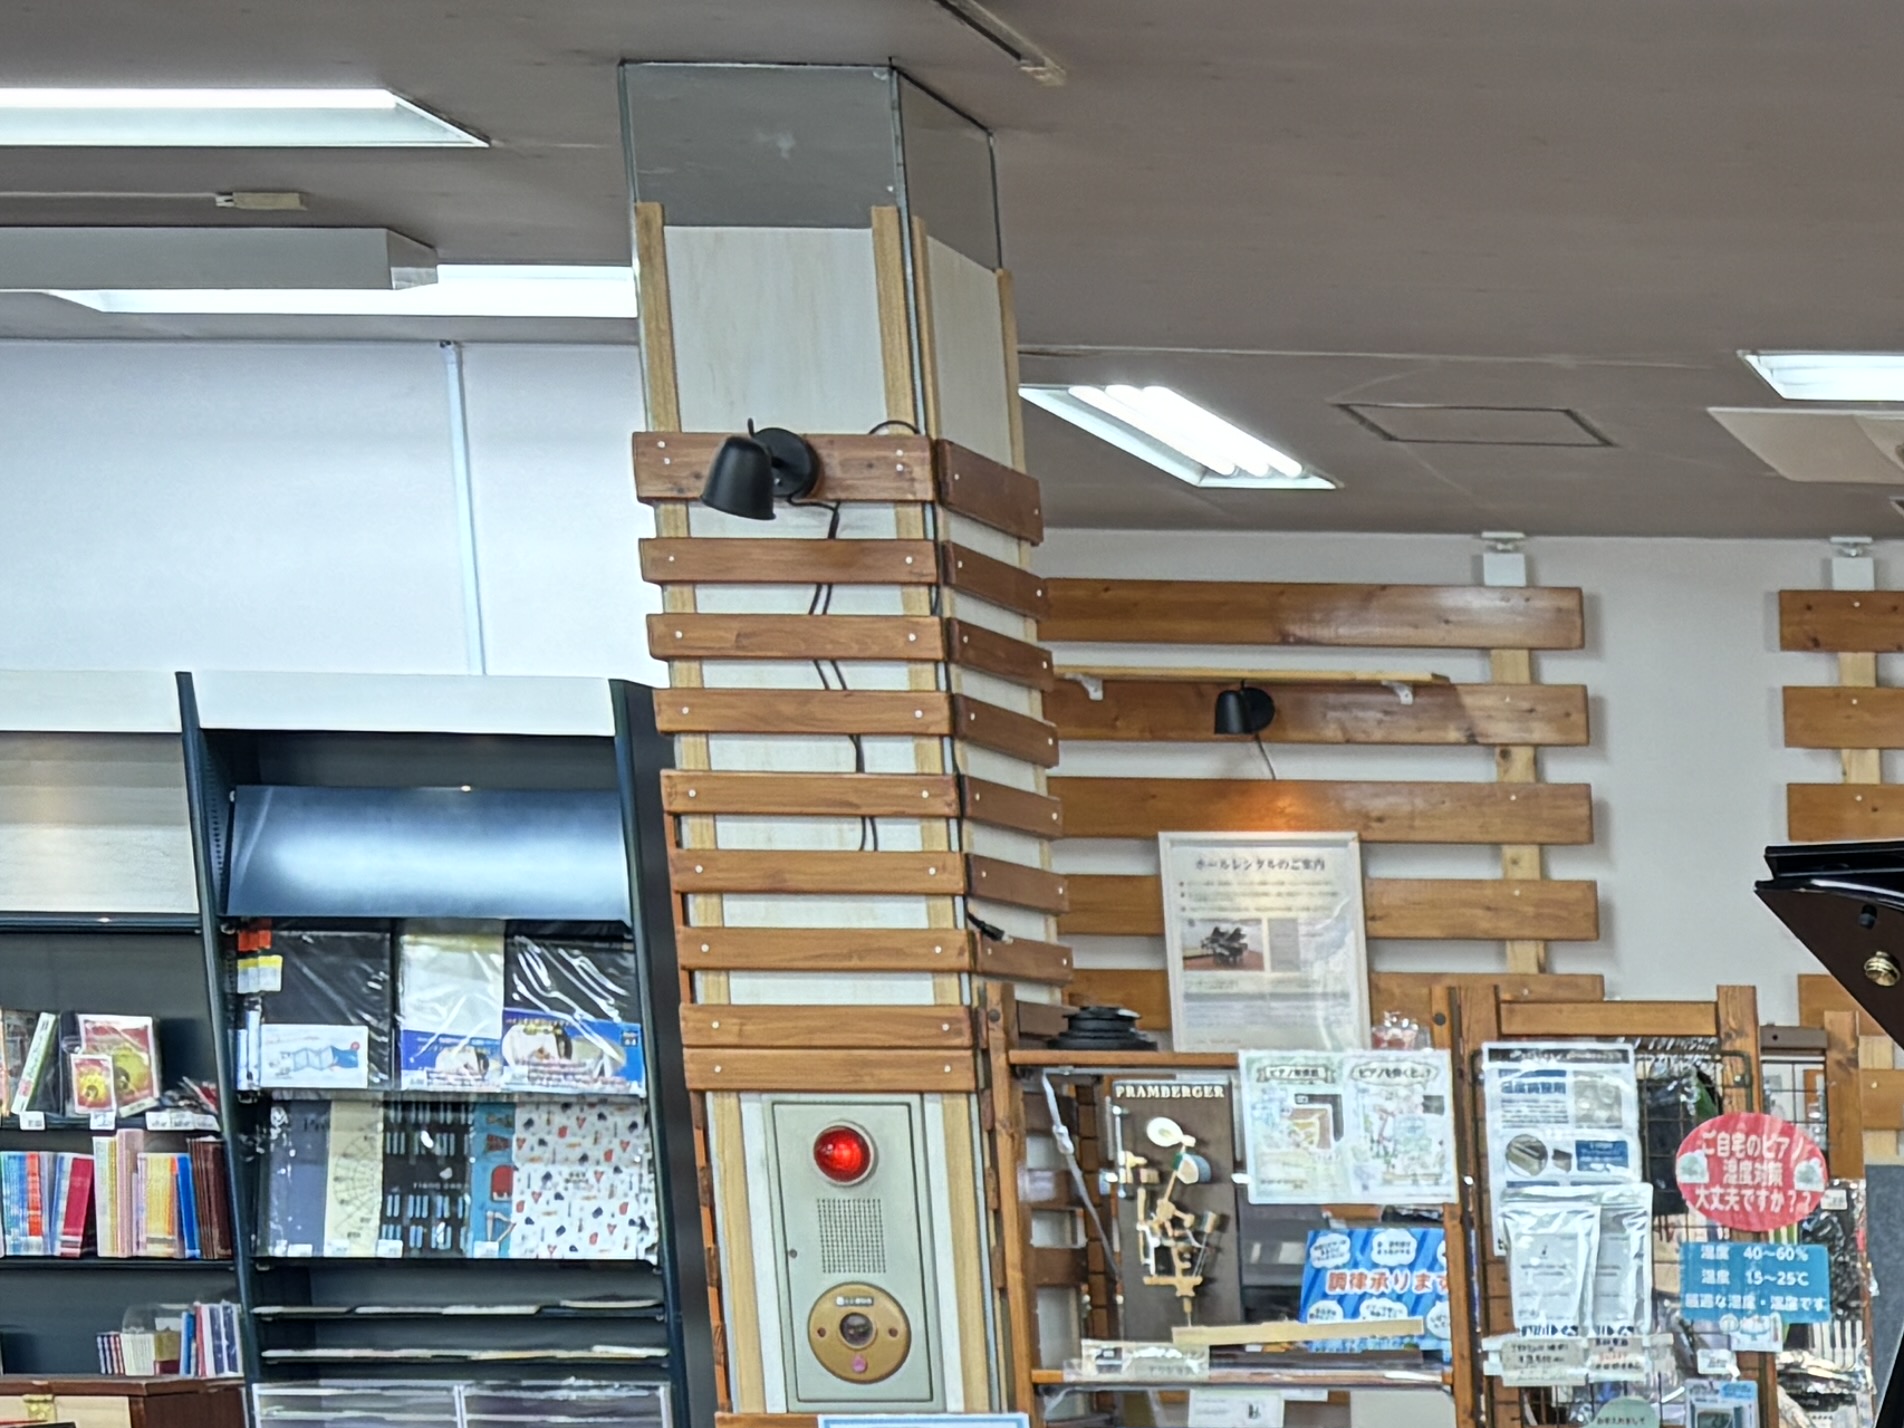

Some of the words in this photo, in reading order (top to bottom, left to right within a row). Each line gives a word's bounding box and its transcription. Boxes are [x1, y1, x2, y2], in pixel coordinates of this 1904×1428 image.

[1114, 1085, 1225, 1100] PRAMBERGER
[1701, 1129, 1804, 1160] ご自宅のピアノ
